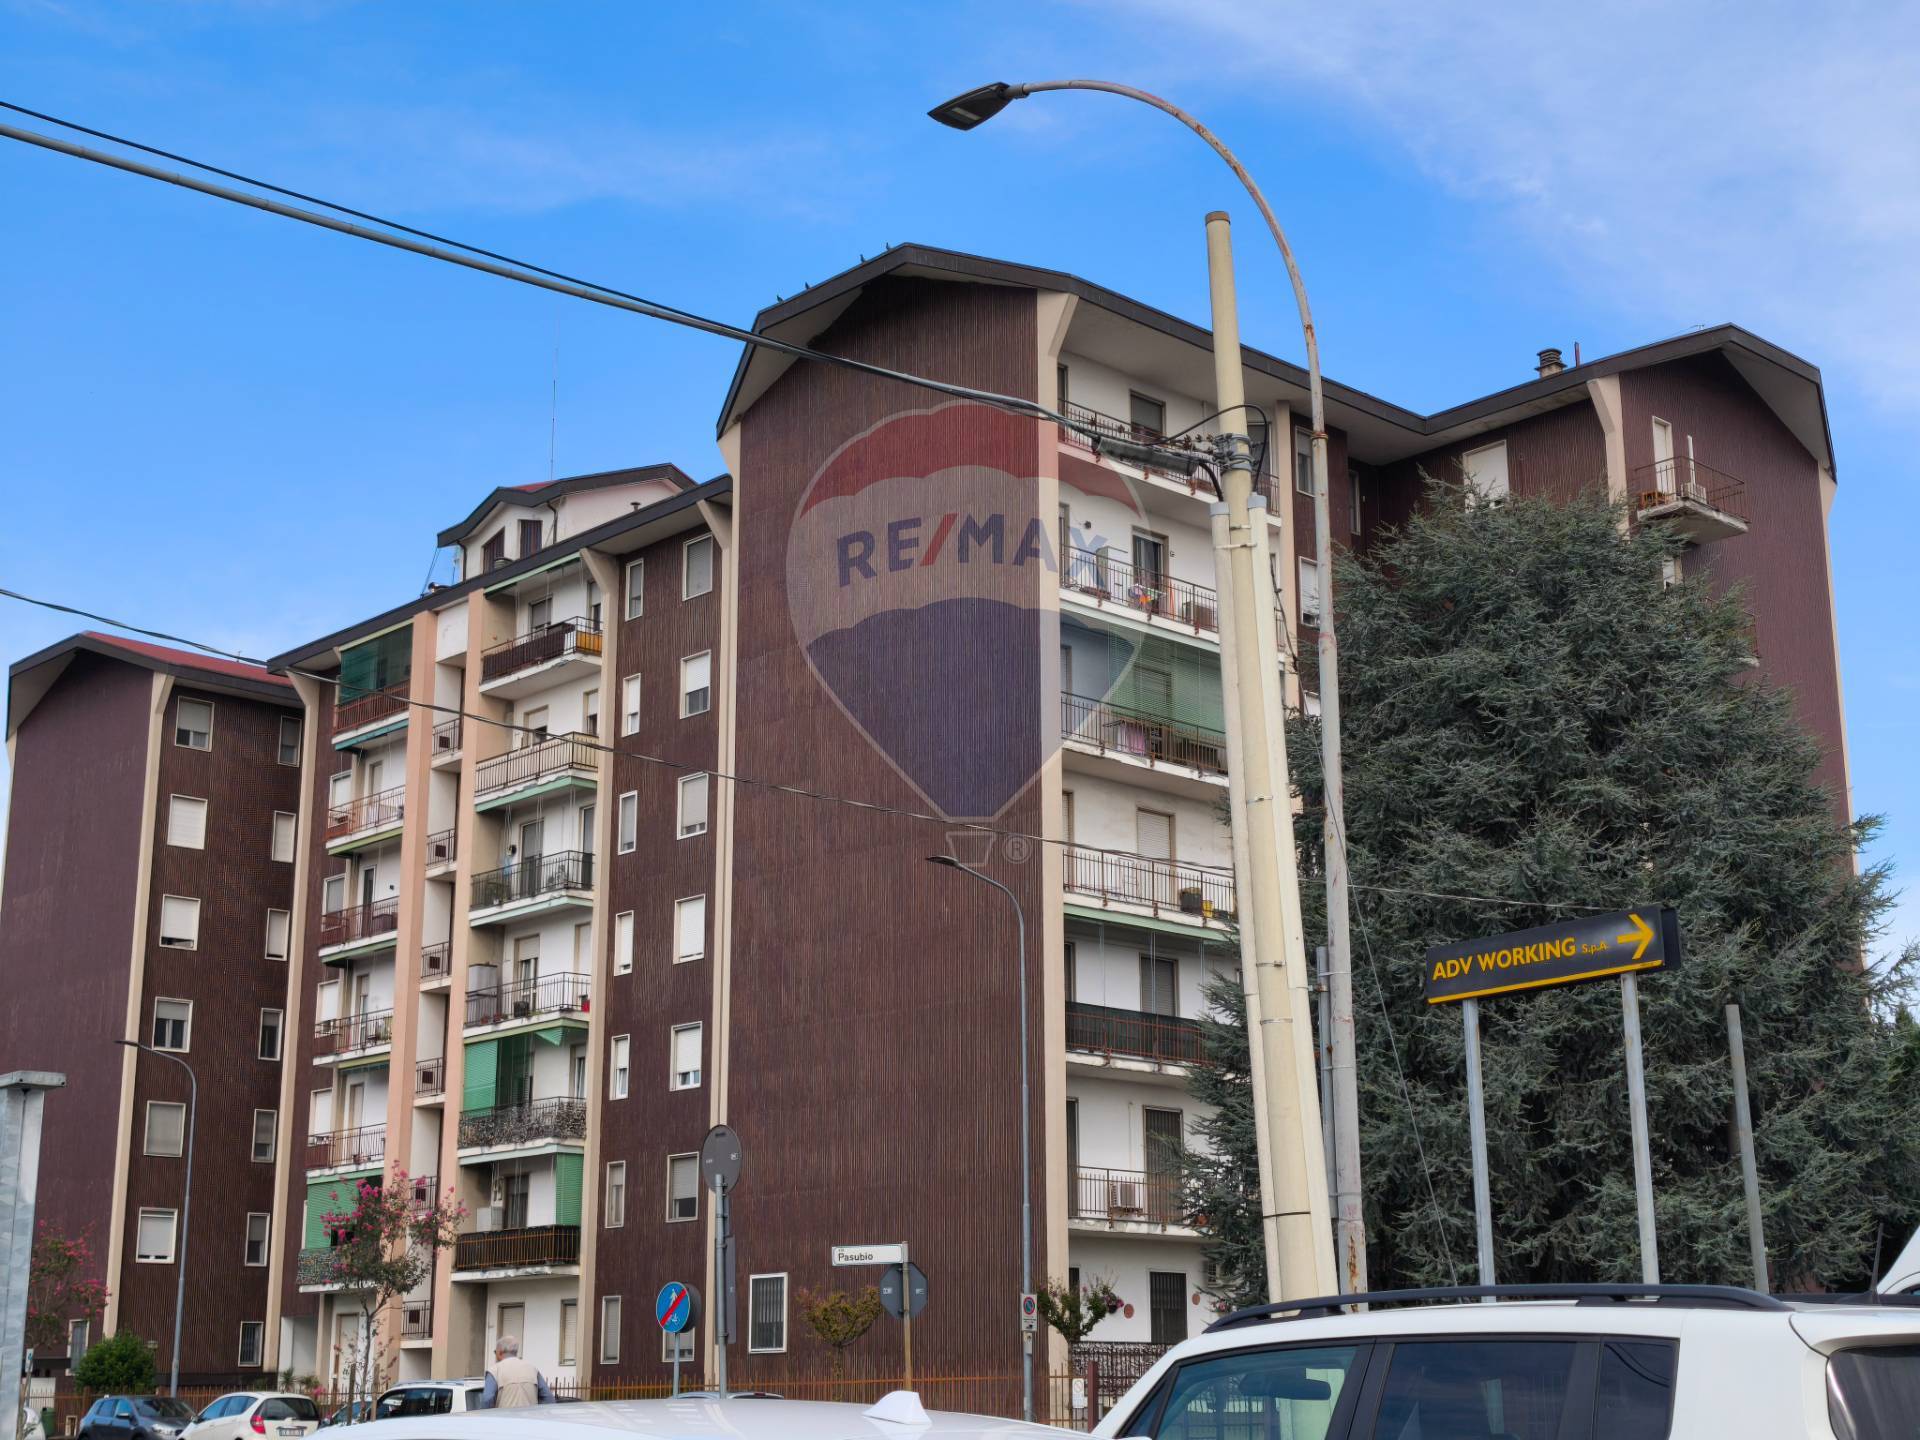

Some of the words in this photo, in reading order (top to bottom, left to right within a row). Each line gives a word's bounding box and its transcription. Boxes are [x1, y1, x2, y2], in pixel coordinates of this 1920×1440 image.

[1432, 956, 1473, 981] ADV
[1477, 937, 1577, 973] WORKING
[838, 1252, 874, 1262] Pasubio
